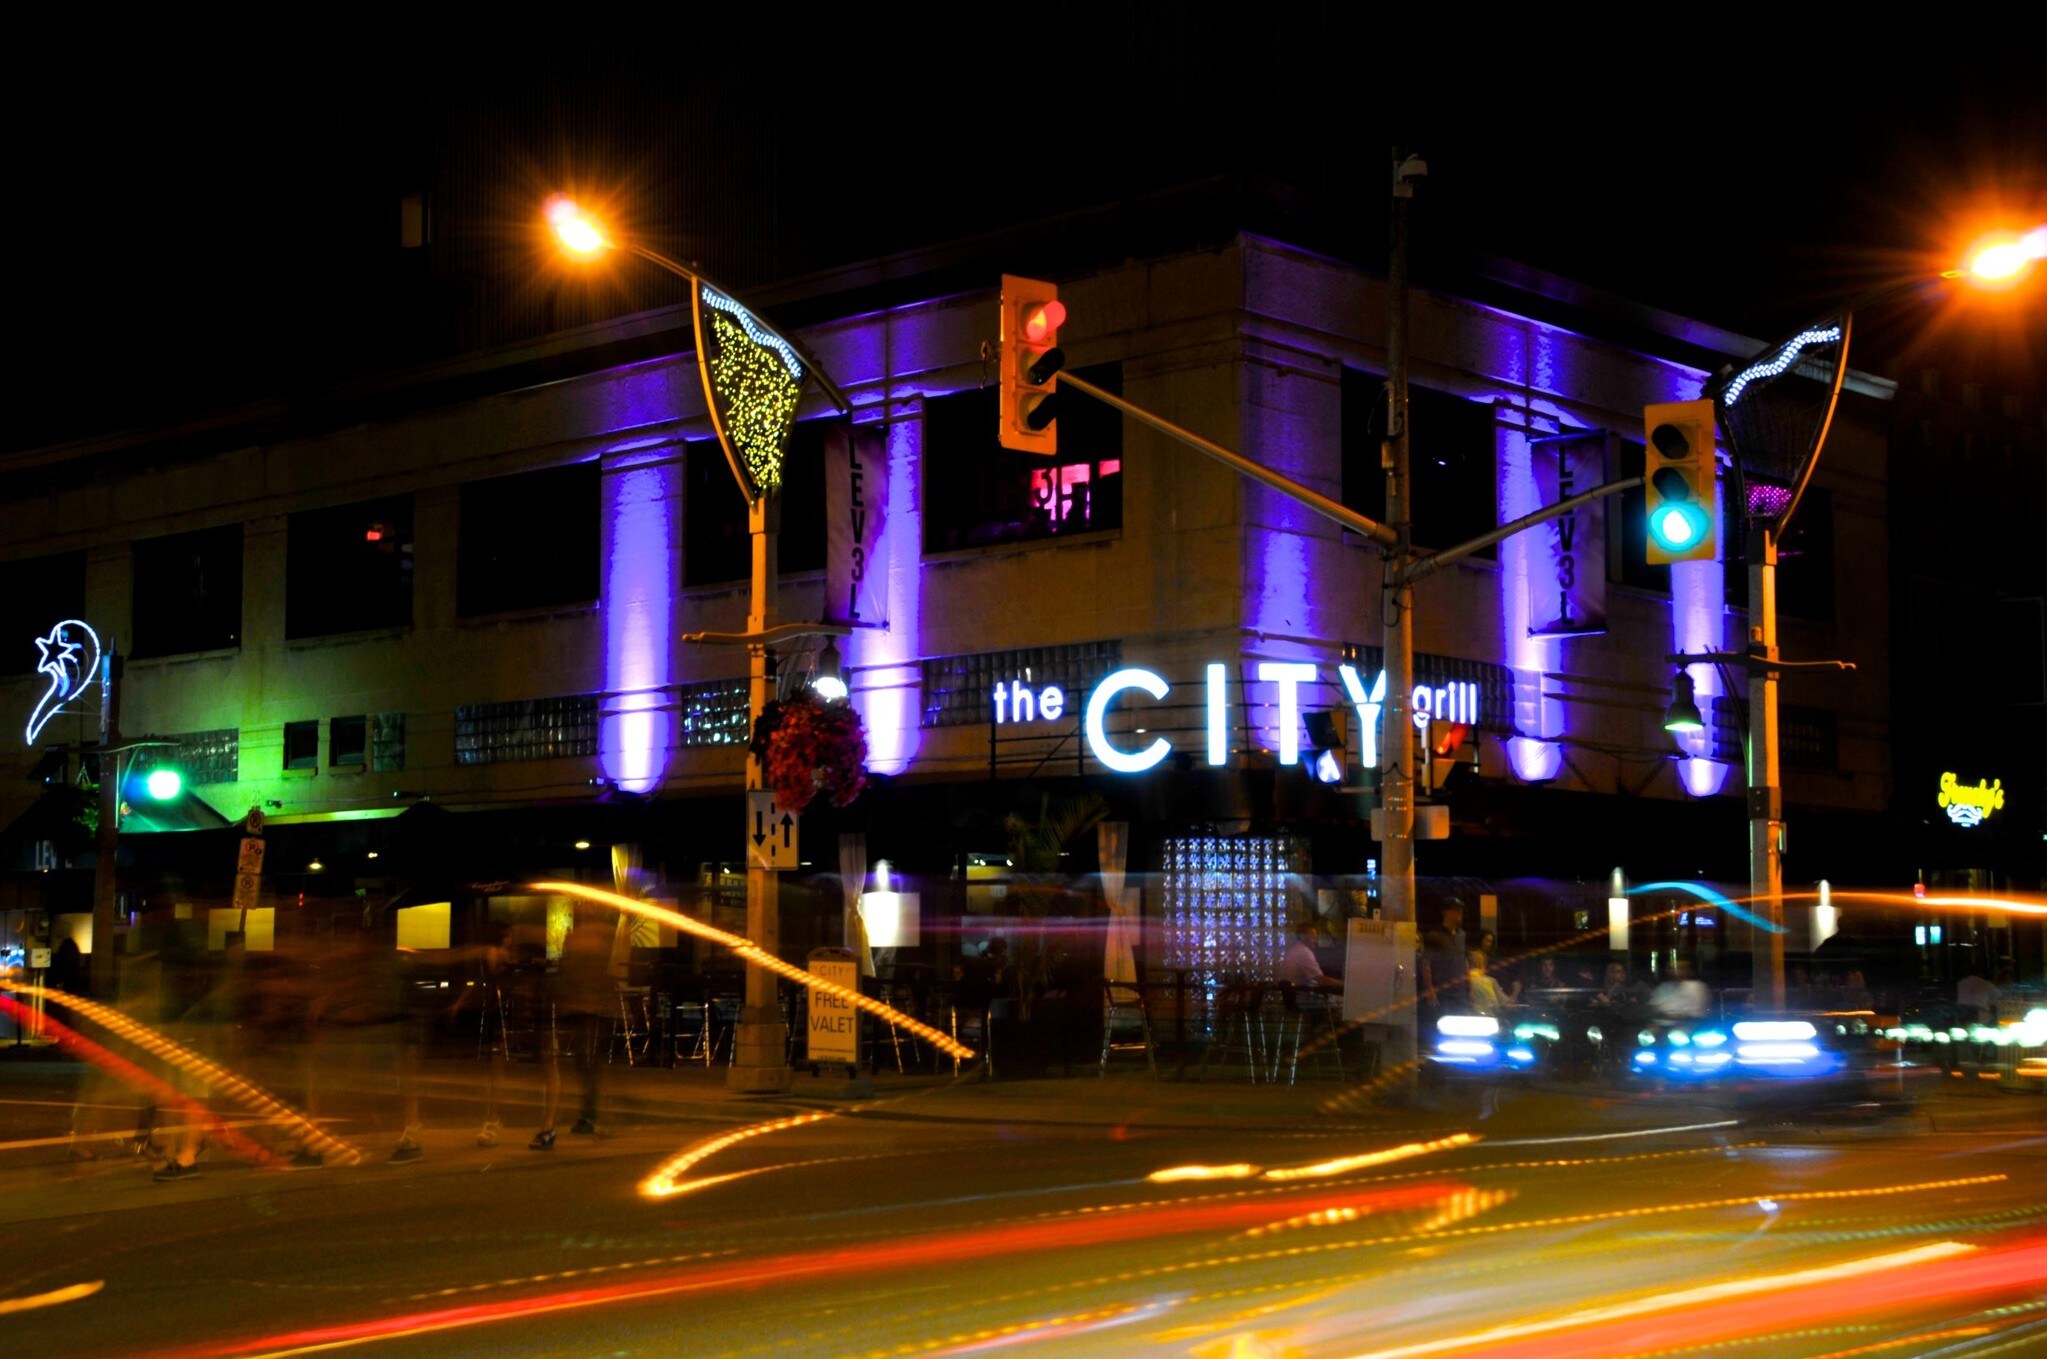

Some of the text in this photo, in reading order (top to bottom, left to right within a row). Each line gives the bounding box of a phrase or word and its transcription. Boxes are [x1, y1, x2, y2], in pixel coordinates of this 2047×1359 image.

[849, 435, 864, 618] LEV3L
[1558, 445, 1575, 625] LEV3L
[993, 664, 1478, 772] the CITY grill
[815, 991, 849, 1009] FREE
[820, 965, 844, 977] CITY
[810, 1015, 854, 1034] VALET
